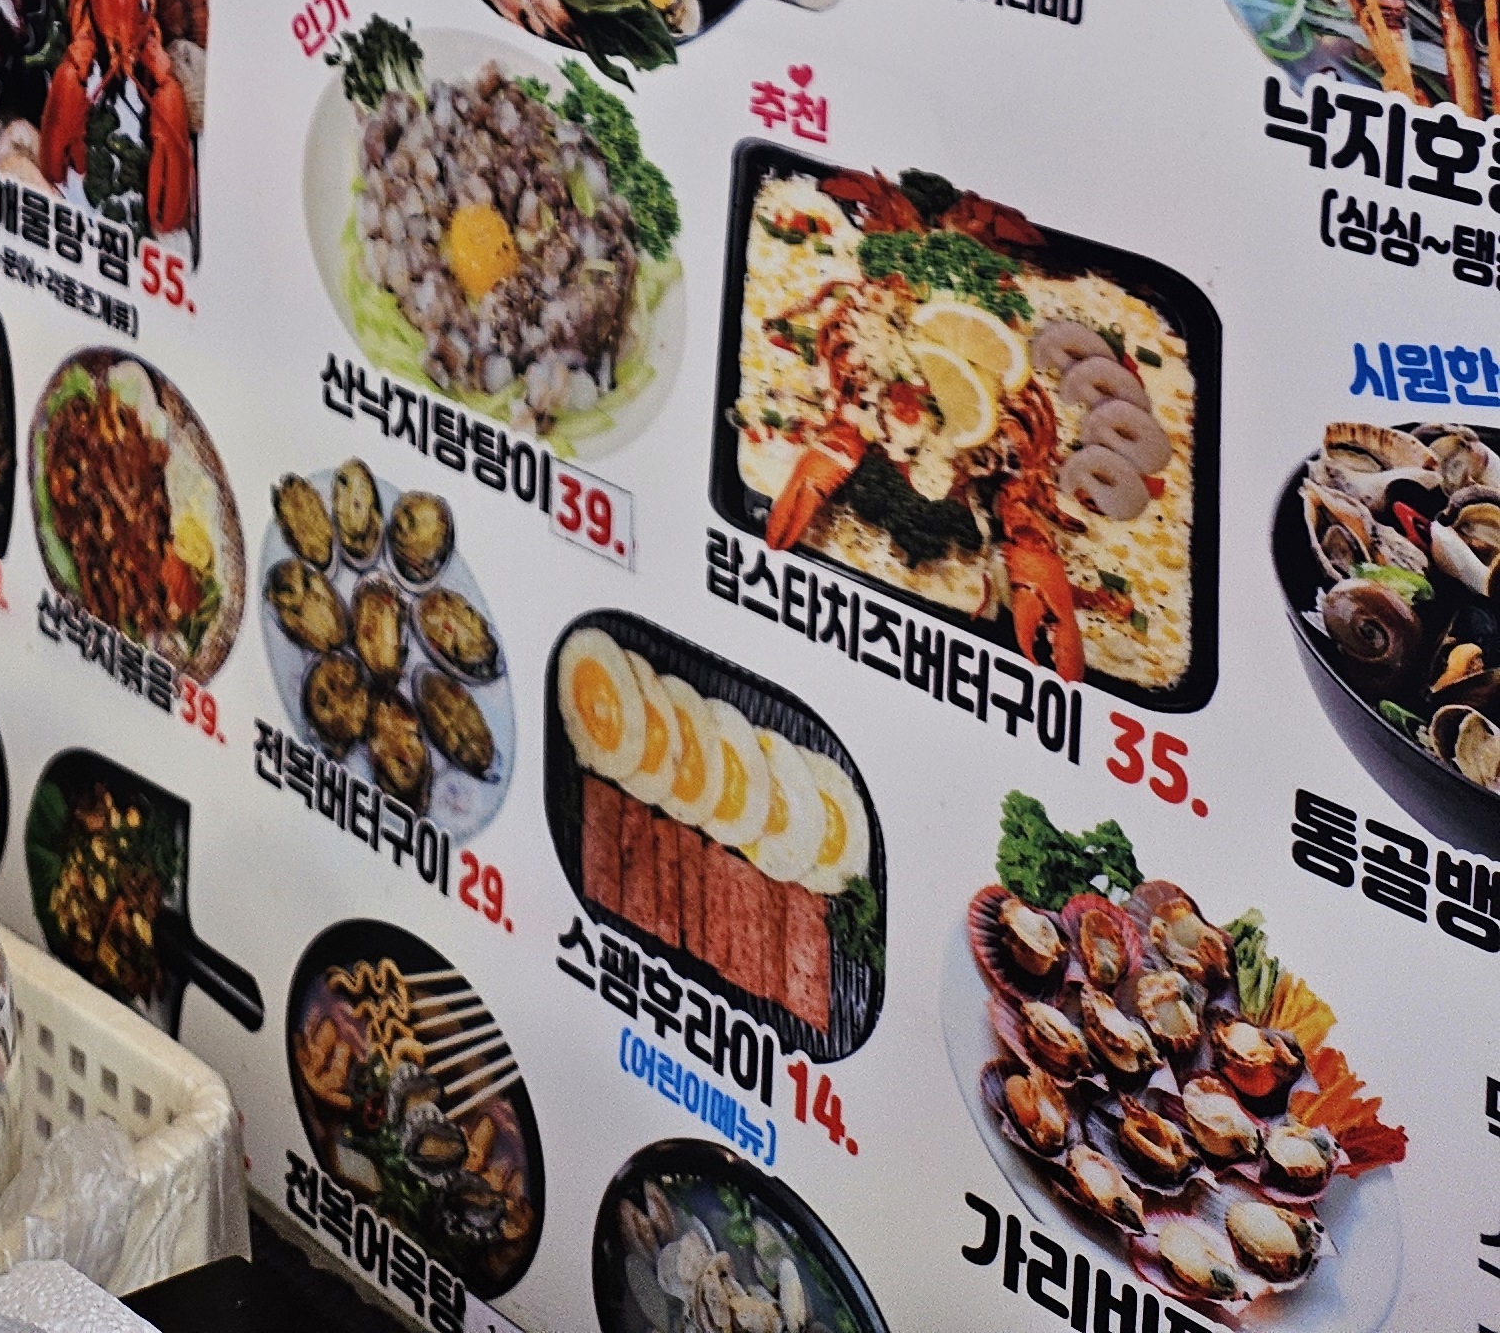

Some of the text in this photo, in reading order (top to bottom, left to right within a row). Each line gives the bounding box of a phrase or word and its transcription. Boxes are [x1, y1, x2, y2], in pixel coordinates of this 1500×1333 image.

[749, 80, 828, 145] 추천
[1264, 76, 1500, 218] 낙지호
[141, 243, 196, 314] 55.
[1320, 188, 1500, 292] (싱싱~탱
[320, 352, 626, 555] 산낙지탕탕이 39.
[1350, 342, 1500, 408] 시원한
[38, 587, 227, 744] 산낙지볶음 39.
[705, 527, 1209, 819] 랍스타치즈버터구이 35.
[253, 716, 514, 933] 전복버터구이 29.
[1291, 788, 1500, 953] 통골뱅
[556, 915, 859, 1156] 스팸후라이 14.
[619, 1027, 777, 1167] (어린이메뉴)
[284, 1149, 467, 1333] 전복어묵탕
